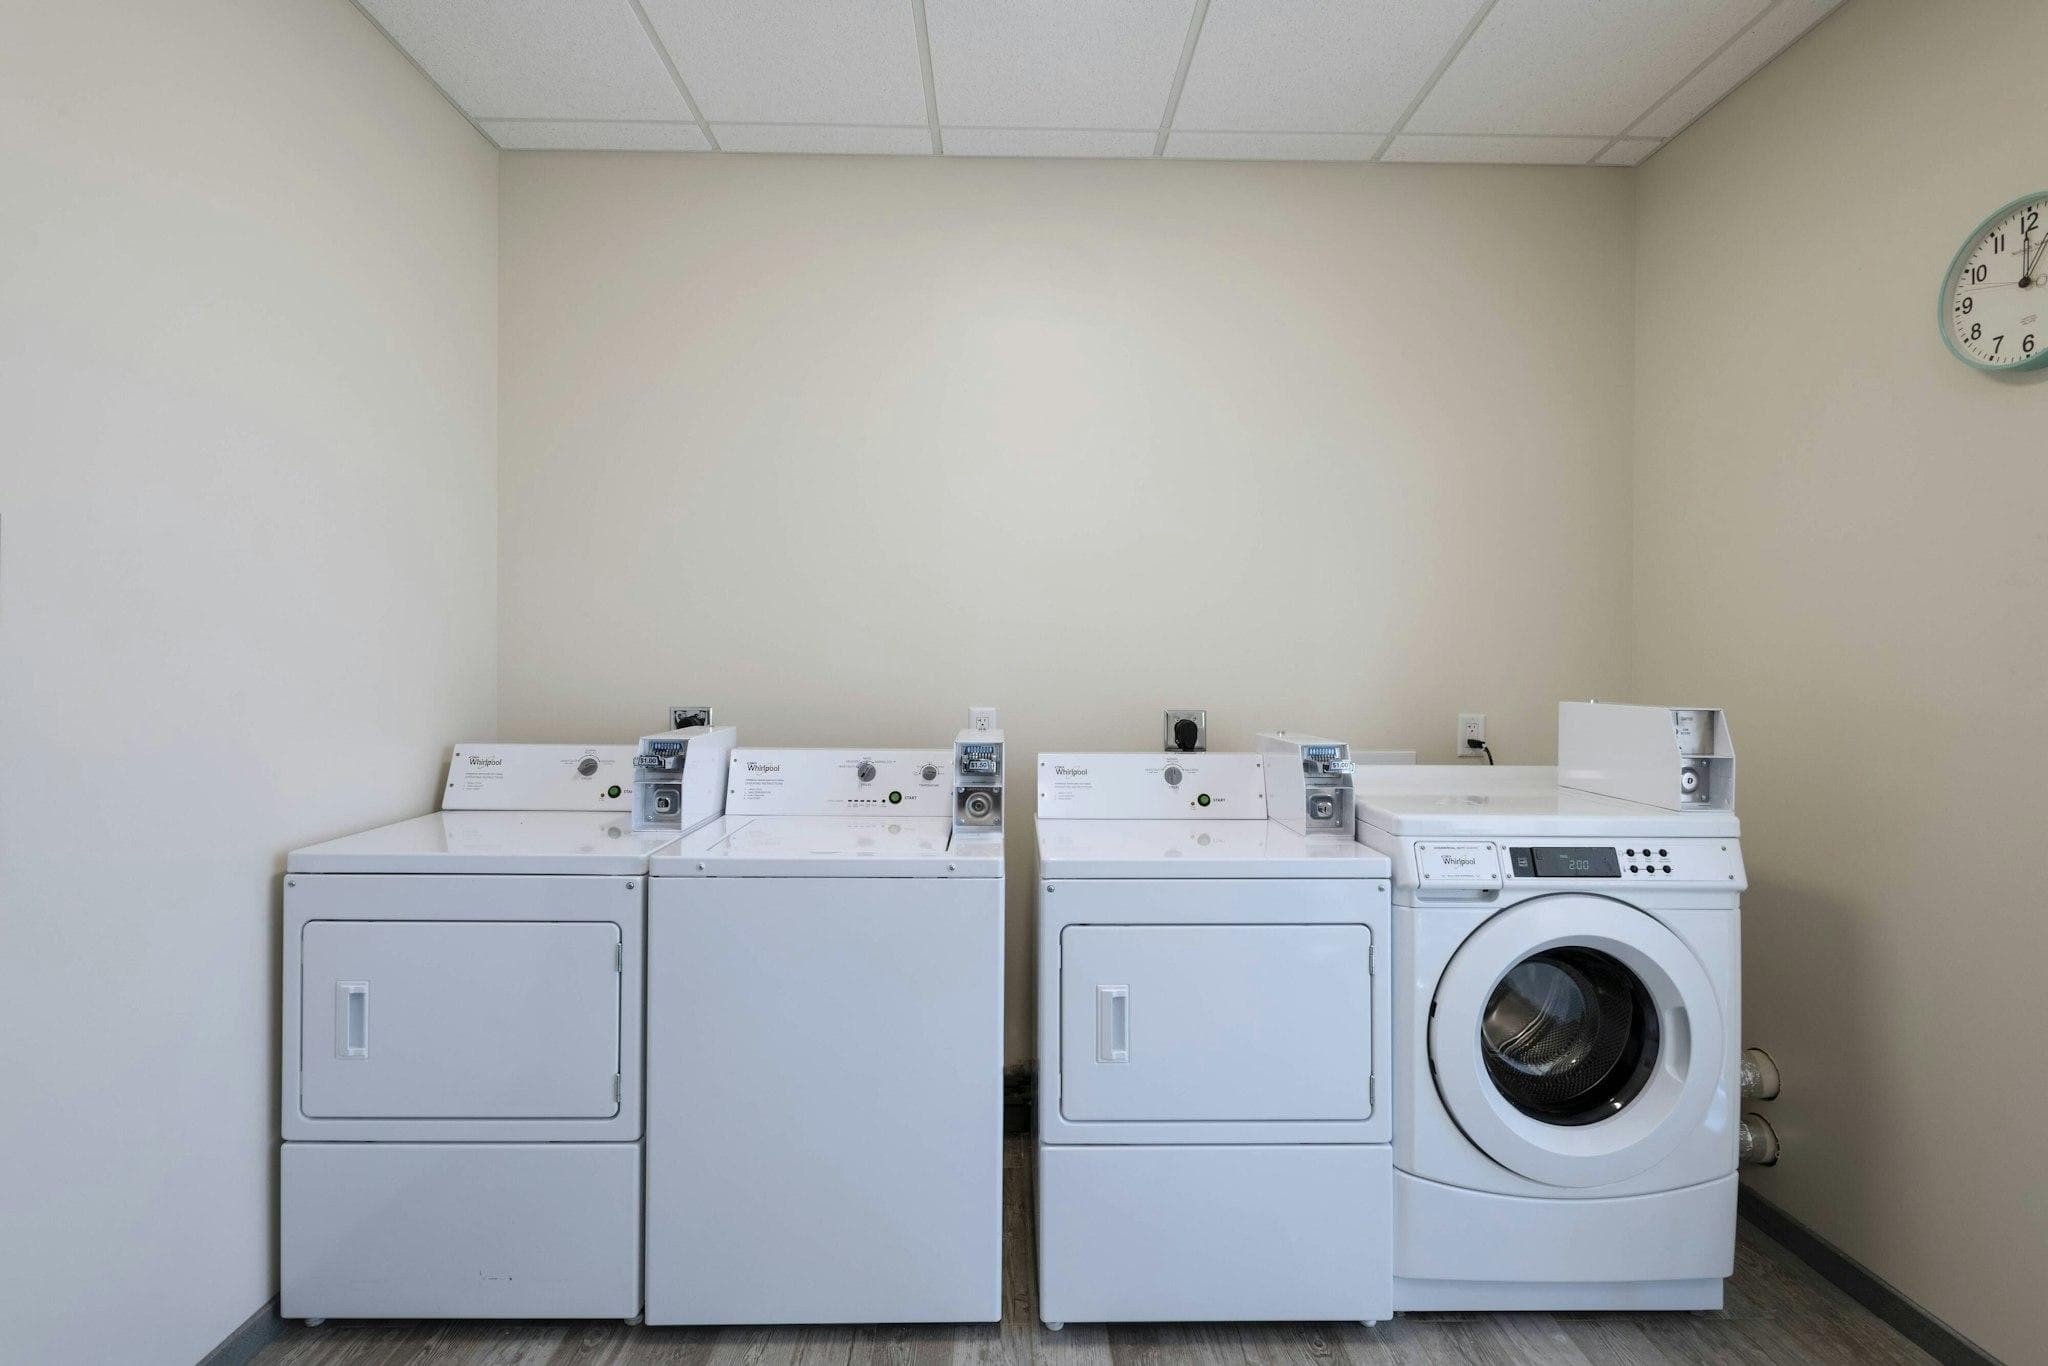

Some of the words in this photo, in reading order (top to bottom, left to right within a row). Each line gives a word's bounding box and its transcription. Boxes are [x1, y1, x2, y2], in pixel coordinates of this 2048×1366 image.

[2020, 211, 2039, 235] 12
[1993, 233, 2005, 255] 11
[1971, 264, 1988, 285] 10
[1961, 296, 1974, 315] 9
[1970, 322, 1982, 341] 8
[1992, 335, 2005, 354] 7
[2022, 334, 2036, 353] 6
[469, 758, 503, 768] Whirlpool
[640, 757, 657, 765] $1.00
[747, 764, 780, 774] Whirlpool
[1055, 768, 1088, 777] Whirlpool
[1442, 857, 1476, 867] Whirlpool
[1568, 860, 1590, 870] 2:00
